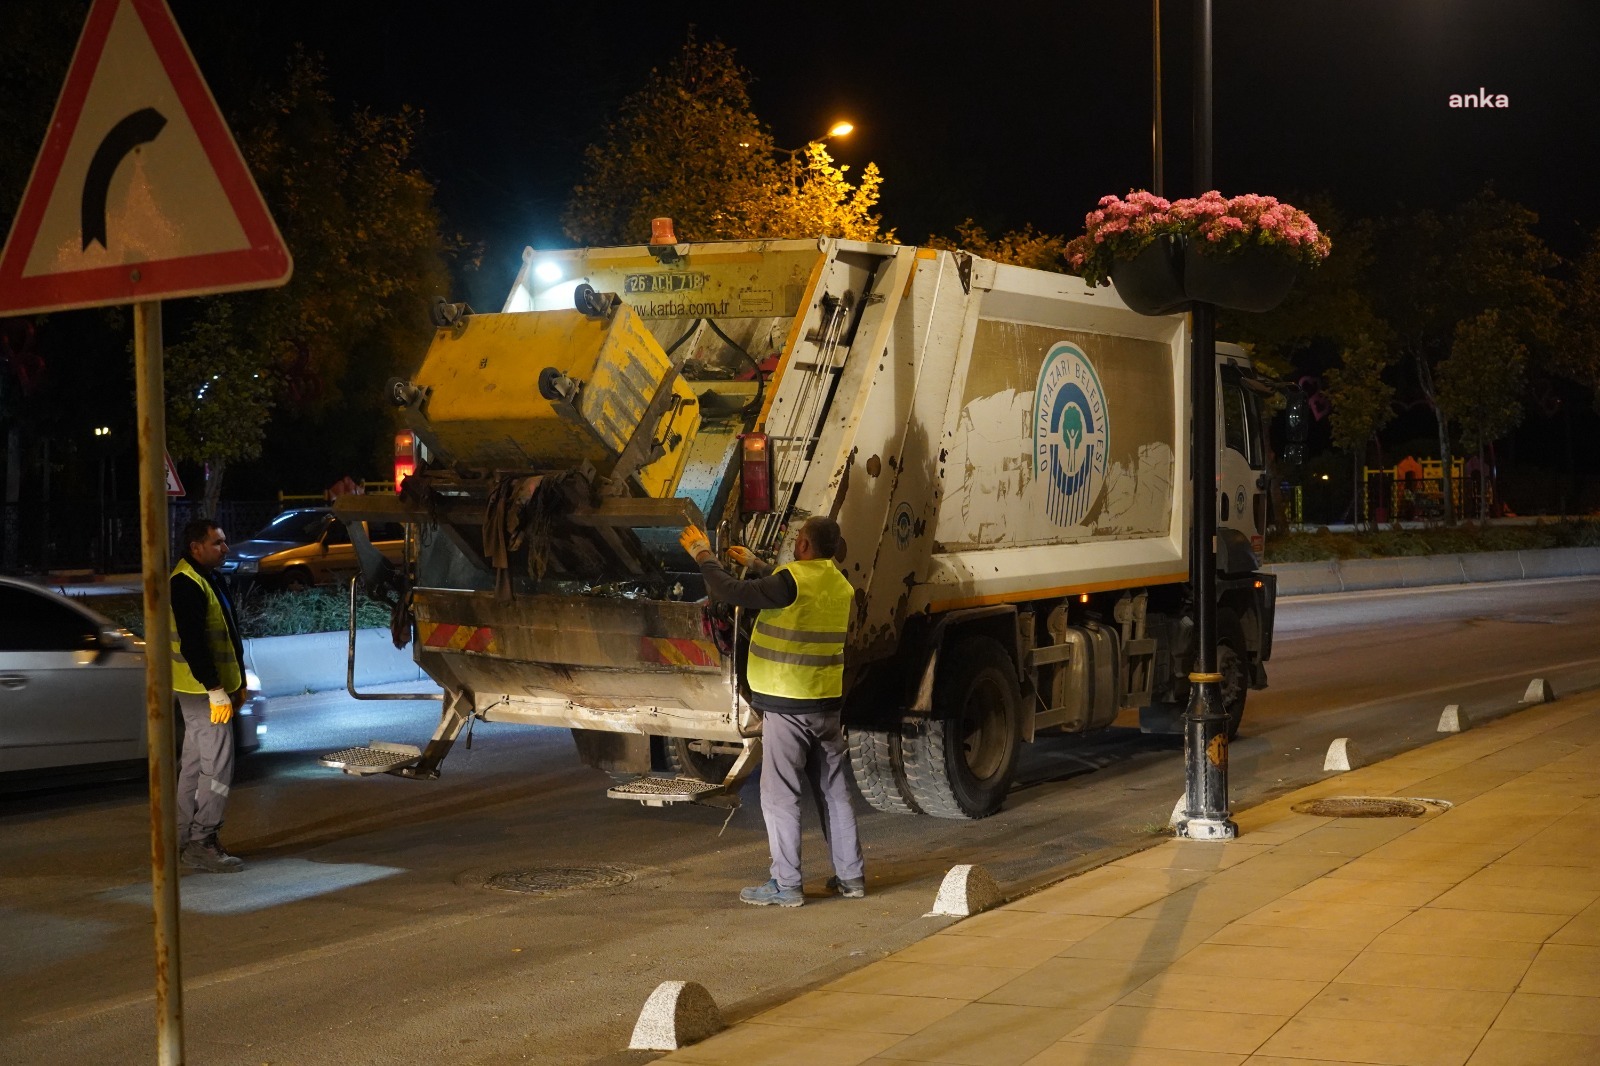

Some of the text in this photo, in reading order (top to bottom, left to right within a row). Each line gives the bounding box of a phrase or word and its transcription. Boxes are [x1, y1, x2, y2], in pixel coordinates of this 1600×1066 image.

[631, 275, 646, 292] 26
[651, 274, 673, 291] ACH
[633, 300, 730, 317] w.karba.com.tr
